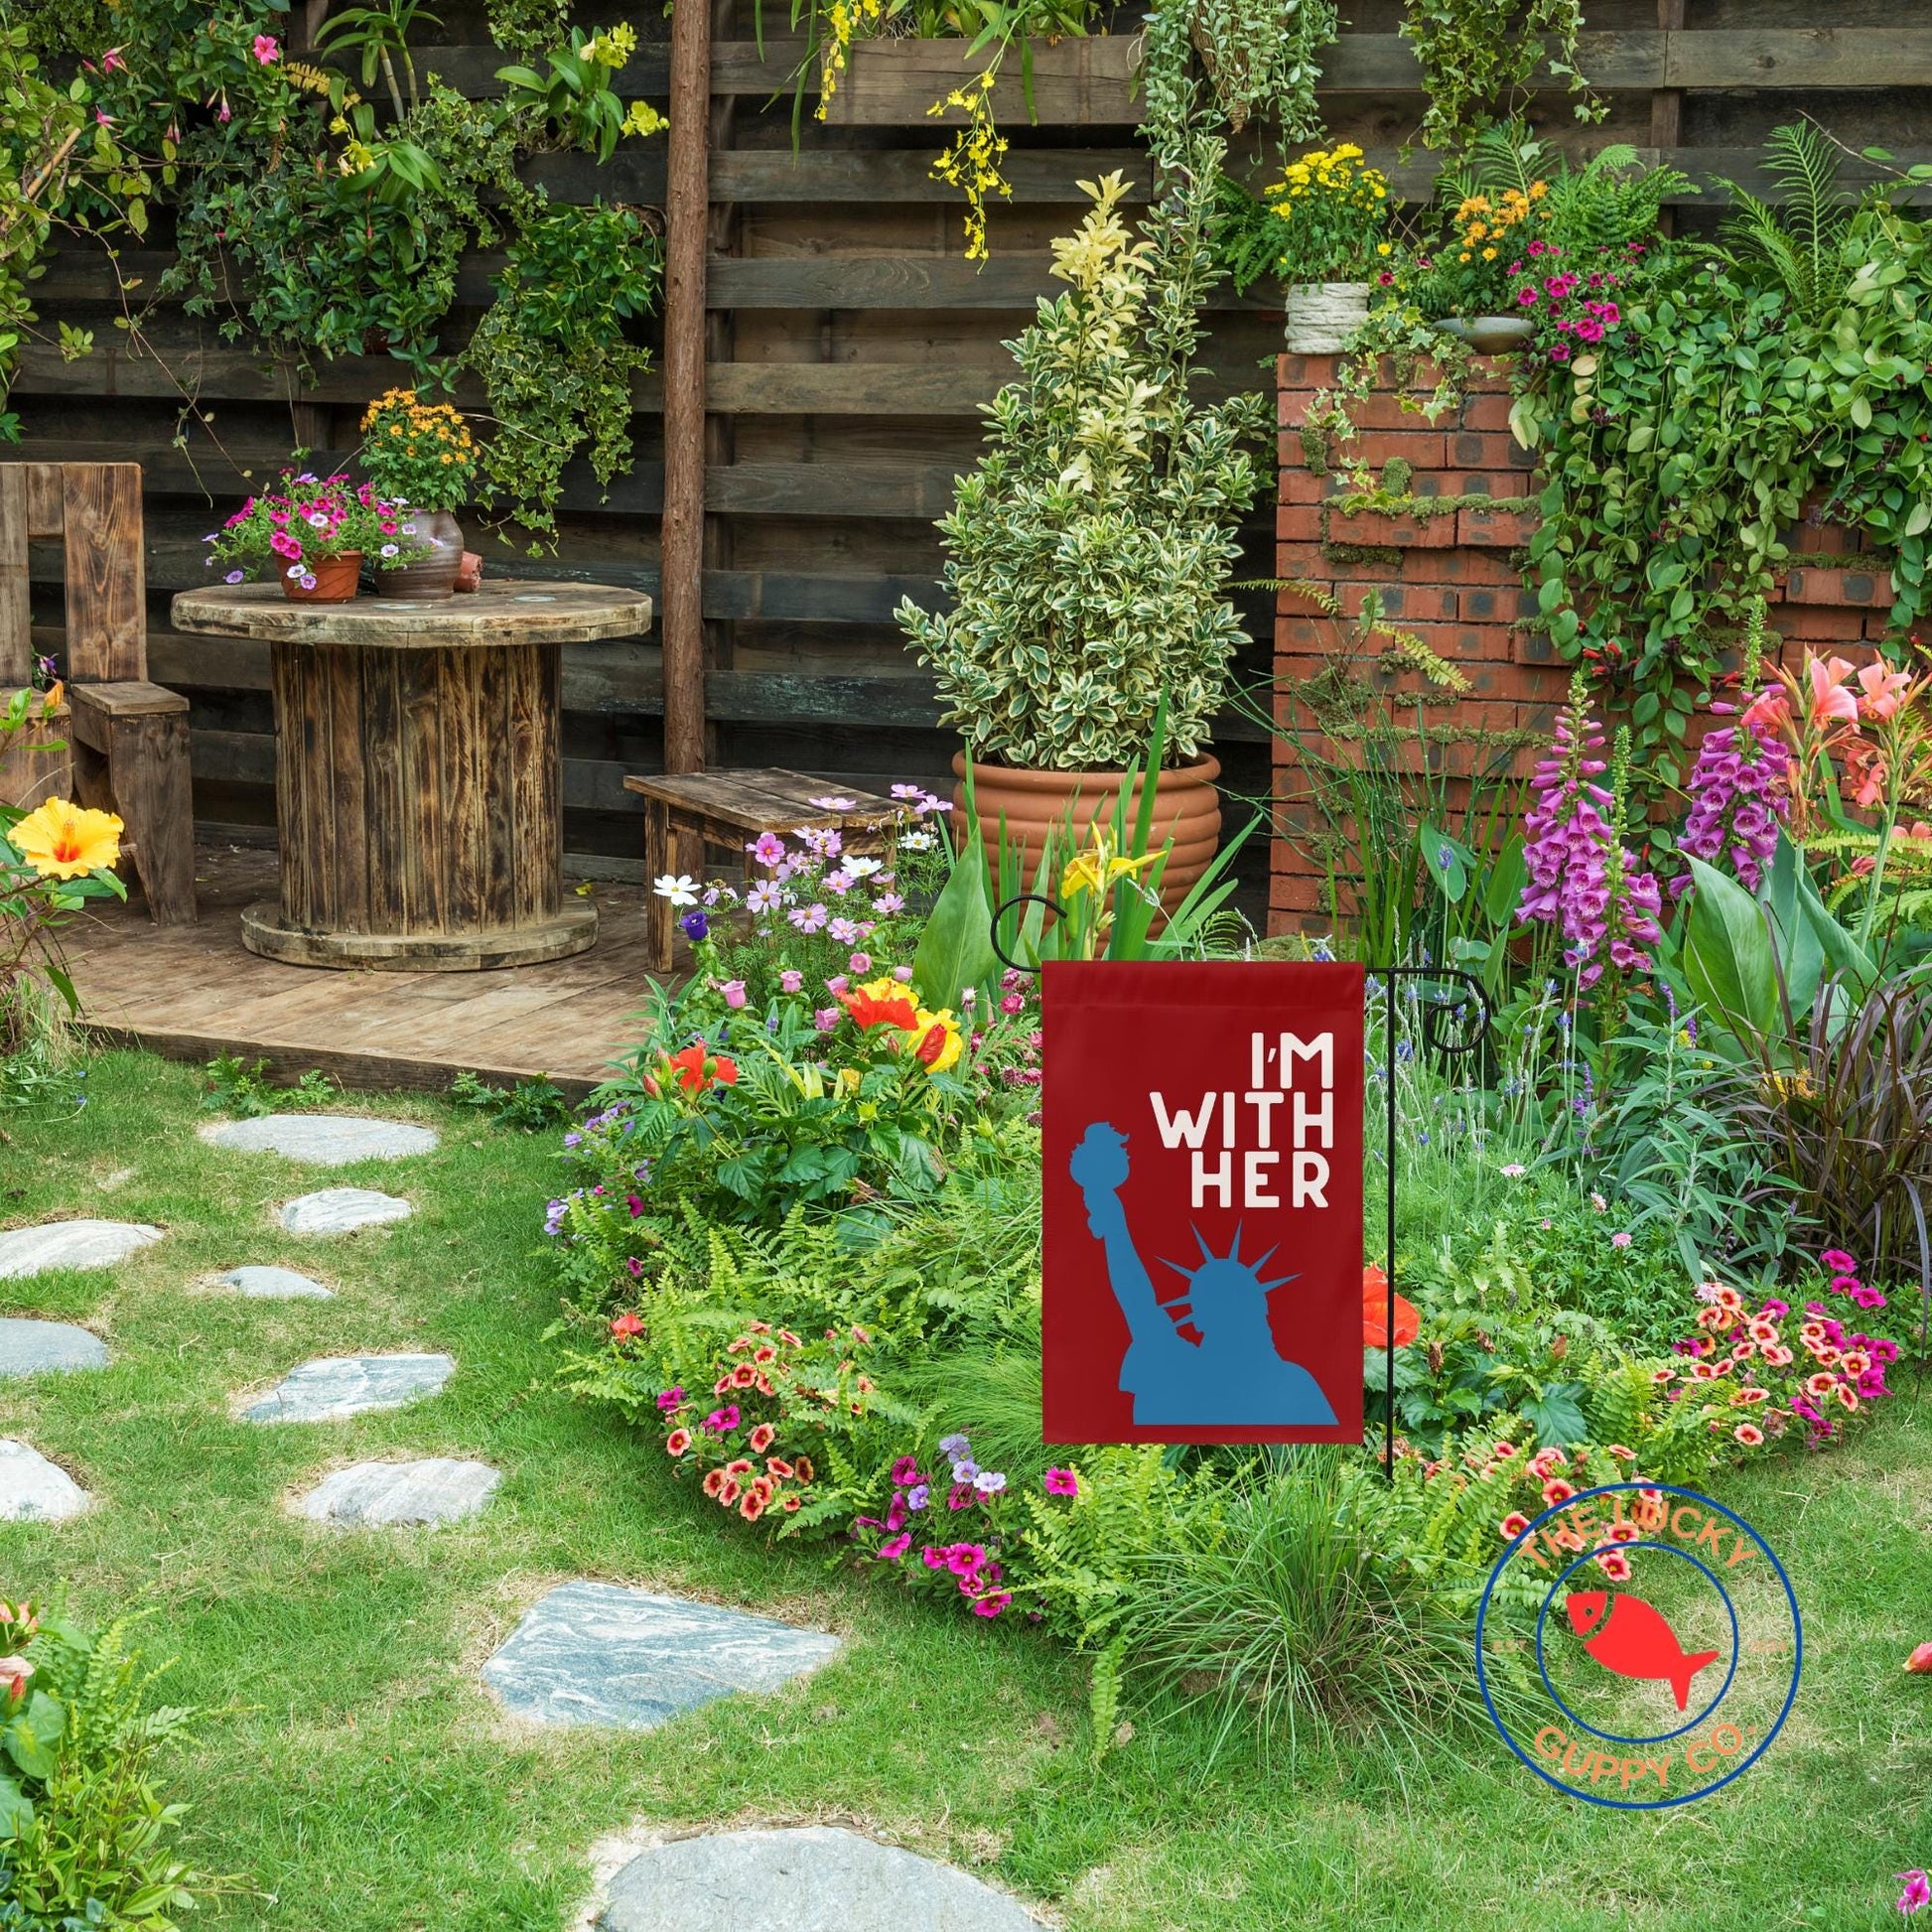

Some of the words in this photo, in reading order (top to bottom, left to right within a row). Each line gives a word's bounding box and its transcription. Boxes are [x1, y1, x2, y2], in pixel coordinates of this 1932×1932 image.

[1251, 1032, 1333, 1089] I'M
[1149, 1091, 1333, 1149] WITH
[1191, 1151, 1330, 1208] HER
